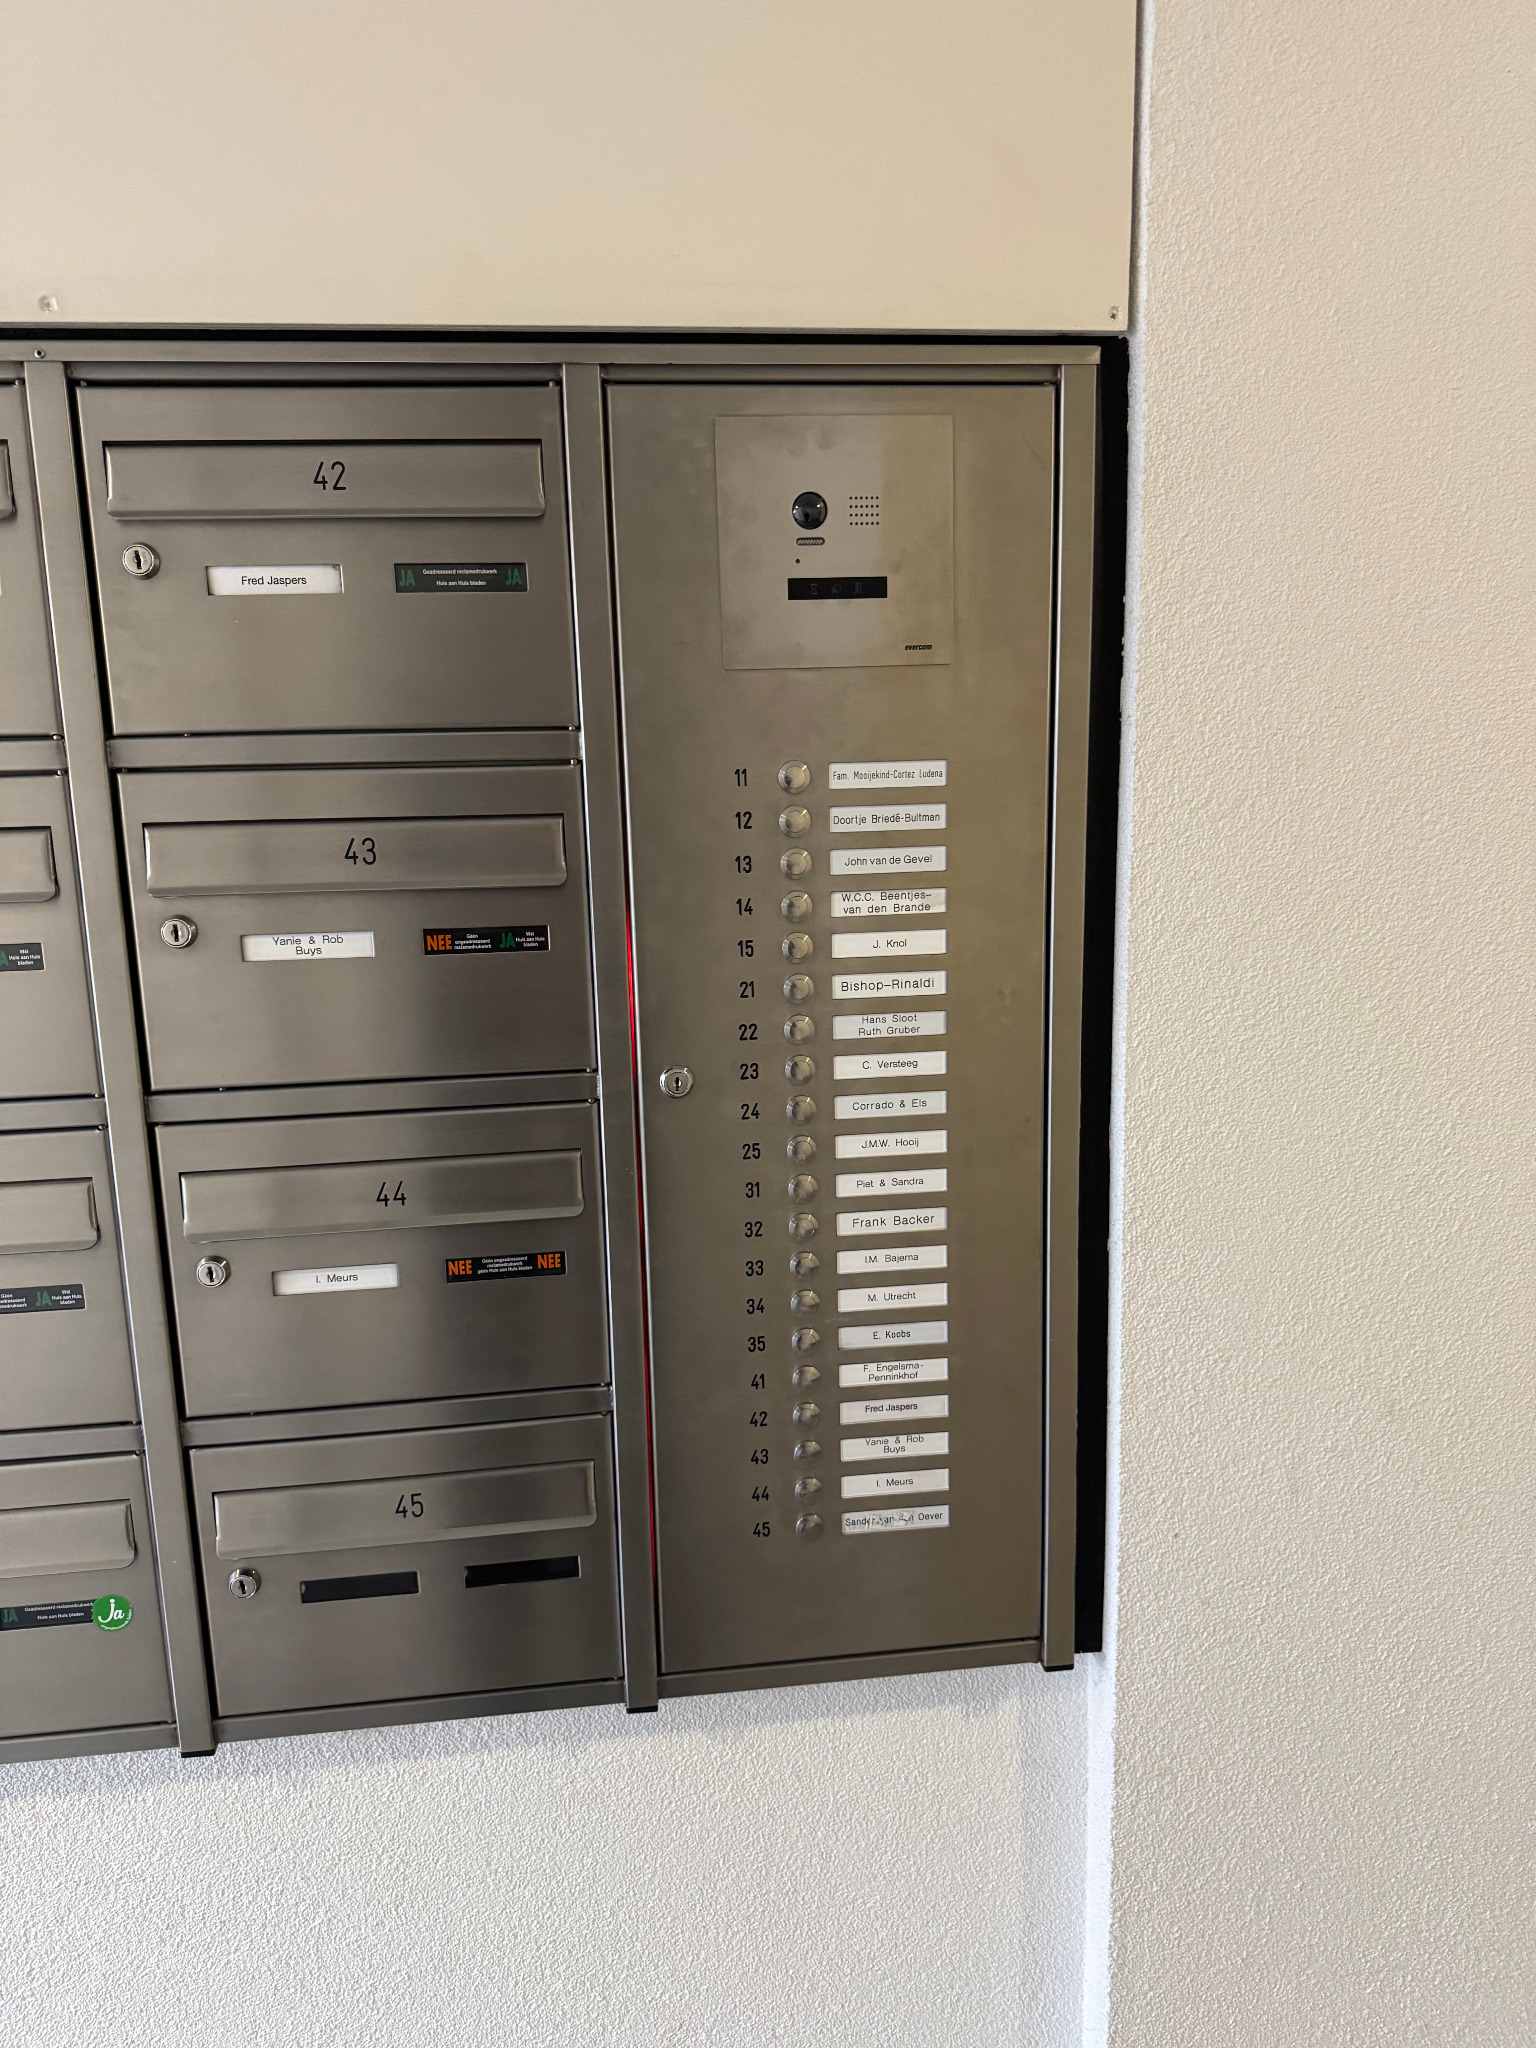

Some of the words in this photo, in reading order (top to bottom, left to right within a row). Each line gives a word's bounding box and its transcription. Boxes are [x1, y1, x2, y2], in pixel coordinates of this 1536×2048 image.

[313, 461, 346, 490] 42
[241, 575, 264, 586] Fred
[267, 575, 307, 587] Jaspers
[400, 569, 416, 586] JA
[505, 568, 521, 585] JA
[735, 769, 748, 786] 11
[736, 812, 752, 829] 12
[833, 815, 867, 826] Doortje
[344, 837, 376, 865] 43
[735, 856, 752, 873] 13
[844, 857, 868, 867] John
[869, 857, 887, 865] van
[889, 855, 901, 865] de
[842, 893, 875, 903] W.C.C.
[736, 898, 753, 915] 14
[843, 906, 862, 915] van
[868, 904, 887, 914] den
[893, 903, 931, 913] Brande
[272, 936, 301, 946] Yanie
[308, 935, 316, 945] &
[322, 934, 344, 944] Rob
[426, 934, 453, 951] NEE
[500, 932, 515, 948] JA
[872, 940, 881, 949] J.
[886, 938, 907, 948] Knol
[295, 946, 322, 957] Buys
[737, 940, 754, 957] 15
[739, 981, 755, 998] 21
[862, 1015, 887, 1024] Hans
[892, 1014, 918, 1023] Sloot
[739, 1024, 758, 1040] 22
[858, 1027, 882, 1036] Ruth
[887, 1025, 921, 1035] Gruber
[740, 1063, 759, 1080] 23
[862, 1061, 872, 1070] C.
[877, 1059, 918, 1069] Versteeg
[741, 1104, 760, 1120] 24
[852, 1101, 894, 1111] Corrado
[899, 1100, 906, 1109] &
[912, 1098, 928, 1108] Els
[895, 1137, 919, 1148] Hooij
[742, 1143, 761, 1159] 25
[745, 1182, 760, 1198] 31
[856, 1179, 875, 1188] Piet
[880, 1178, 886, 1187] &
[891, 1176, 924, 1186] Sandra
[376, 1181, 406, 1207] 44
[744, 1221, 763, 1237] 32
[852, 1217, 886, 1228] Frank
[893, 1214, 935, 1225] Backer
[447, 1260, 473, 1276] NEE
[537, 1253, 561, 1270] NEE
[745, 1260, 764, 1276] 33
[316, 1275, 321, 1284] I.
[327, 1273, 358, 1283] Meurs
[35, 1289, 52, 1307] JA
[867, 1294, 879, 1302] M.
[884, 1291, 916, 1301] Utrecht
[746, 1298, 765, 1314] 34
[873, 1331, 880, 1340] E.
[747, 1336, 766, 1352] 35
[863, 1364, 872, 1373] F.
[868, 1371, 918, 1382] Penninkhof
[751, 1374, 765, 1390] 41
[865, 1404, 884, 1414] Fred
[885, 1402, 918, 1413] Jaspers
[750, 1411, 768, 1427] 42
[894, 1436, 901, 1445] &
[906, 1434, 925, 1443] Rob
[751, 1449, 769, 1465] 43
[883, 1445, 906, 1455] Buys
[876, 1479, 881, 1488] I.
[886, 1477, 914, 1487] Meurs
[752, 1487, 769, 1501] 44
[395, 1493, 424, 1518] 45
[918, 1511, 944, 1521] Oever
[752, 1522, 771, 1537] 45
[0, 1608, 18, 1623] JA
